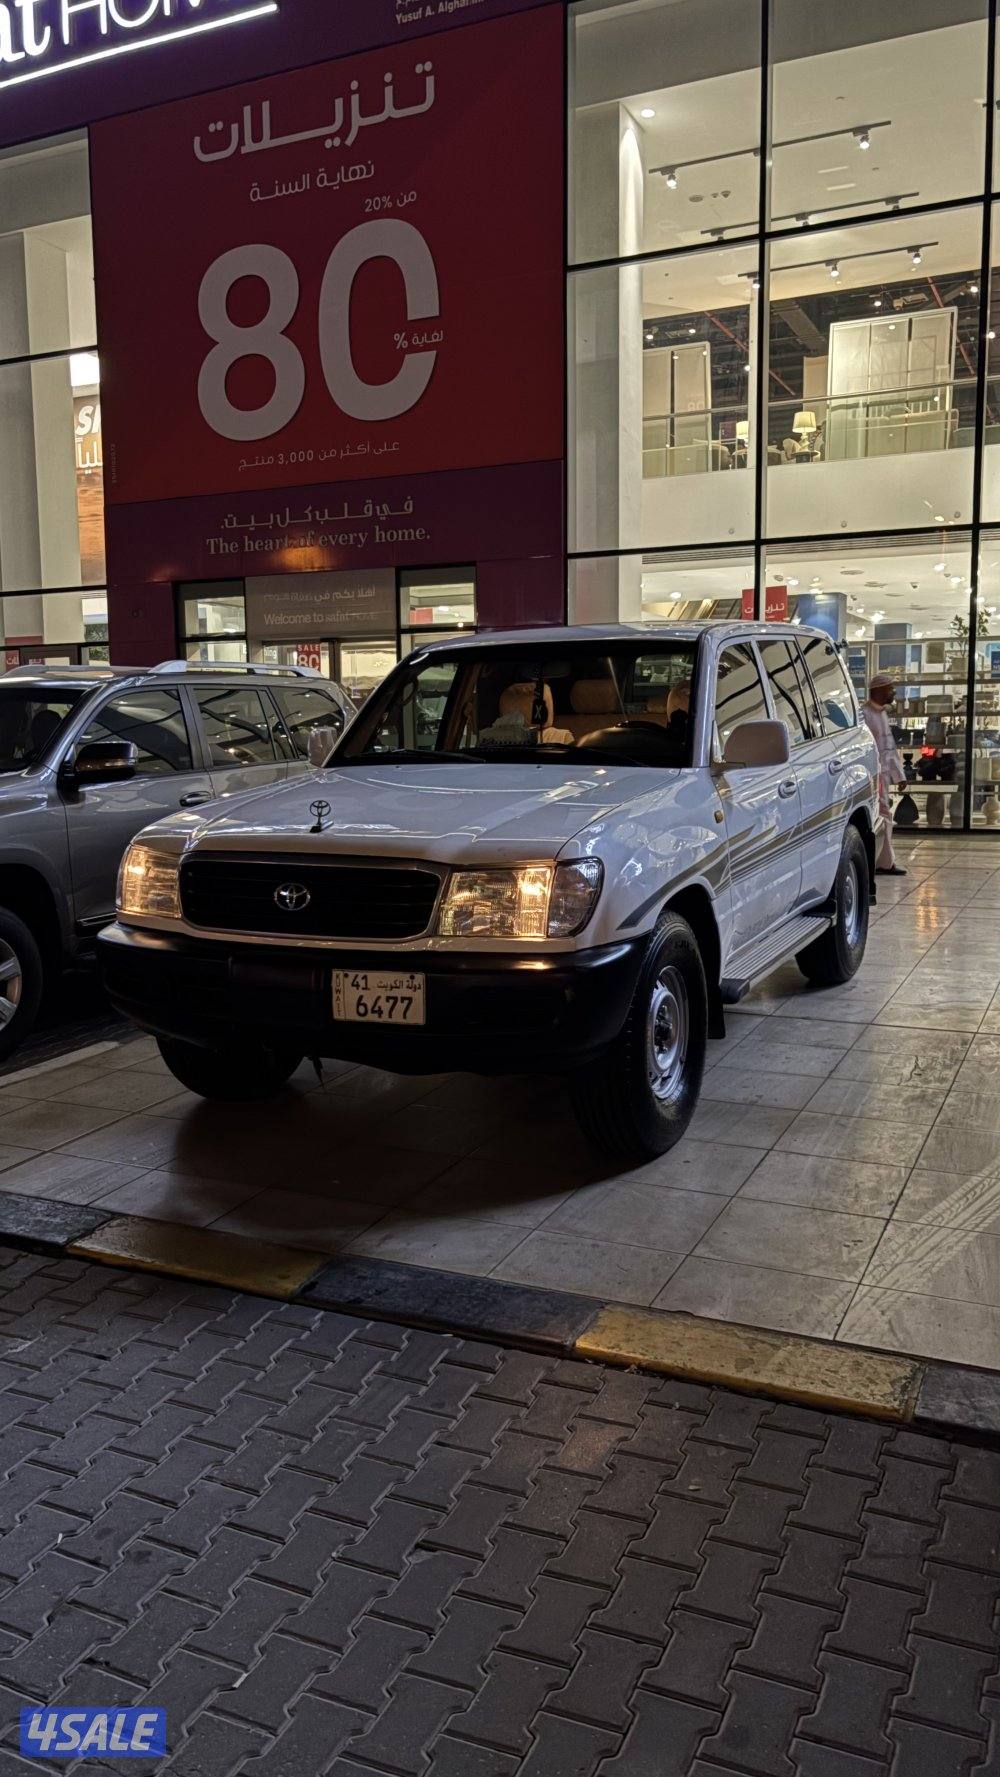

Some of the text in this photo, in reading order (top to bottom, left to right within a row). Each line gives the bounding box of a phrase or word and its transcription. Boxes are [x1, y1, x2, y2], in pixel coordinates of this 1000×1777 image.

[395, 7, 424, 25] Yusuf
[193, 60, 436, 163] تنزيلات
[248, 159, 375, 203] نهاية السنة
[363, 190, 418, 214] من 20%
[197, 219, 440, 442] 80
[412, 329, 444, 348] لغاية
[277, 448, 315, 466] 3,000
[318, 446, 338, 462] من
[373, 440, 401, 456] على
[237, 455, 274, 473] منتج
[276, 505, 314, 528] كل
[314, 498, 374, 526] قلب
[375, 495, 414, 521] في
[206, 537, 239, 555] The
[319, 530, 369, 549] every
[373, 524, 431, 544] home.
[263, 611, 311, 627] Welcome
[313, 610, 325, 624] to
[297, 643, 320, 652] SALE
[350, 973, 371, 991] 41
[334, 973, 342, 1017] KUWAIT
[355, 994, 414, 1020] 6477
